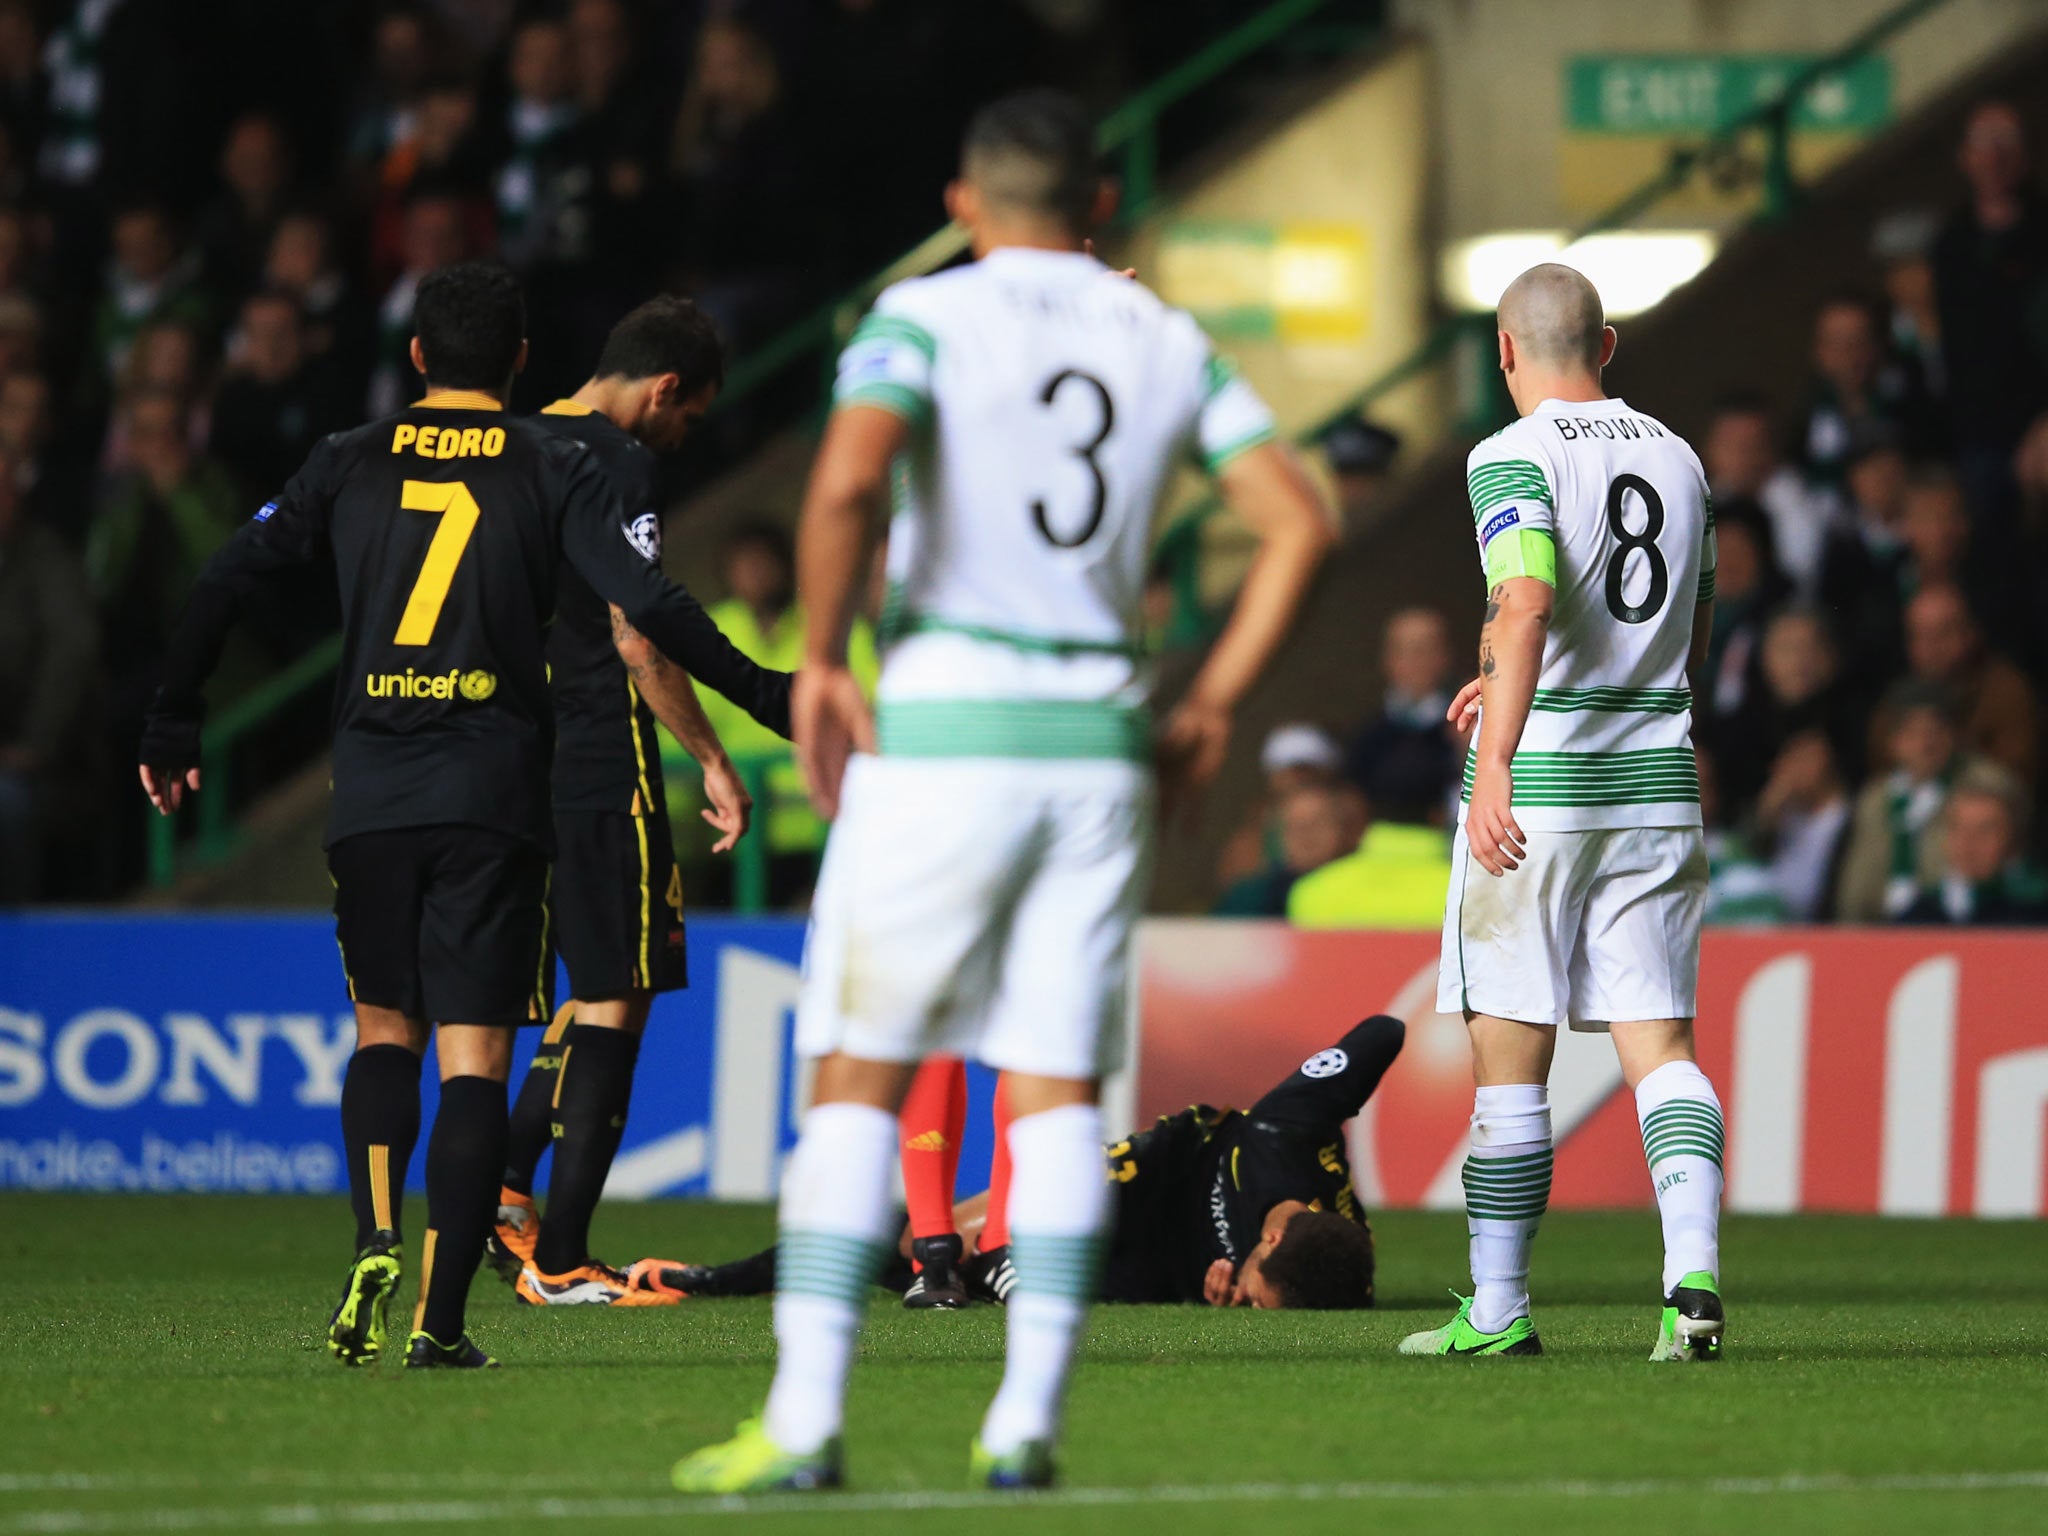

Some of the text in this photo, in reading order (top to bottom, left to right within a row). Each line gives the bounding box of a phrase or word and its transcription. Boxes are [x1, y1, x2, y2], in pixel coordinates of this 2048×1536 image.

[391, 424, 506, 460] PEDRO
[1032, 368, 1115, 548] 3
[1553, 417, 1664, 440] BROWN
[1484, 509, 1518, 540] RESPECT
[1604, 473, 1668, 624] 8
[393, 479, 481, 646] 7
[366, 667, 459, 700] unicef
[0, 1004, 357, 1110] SONY
